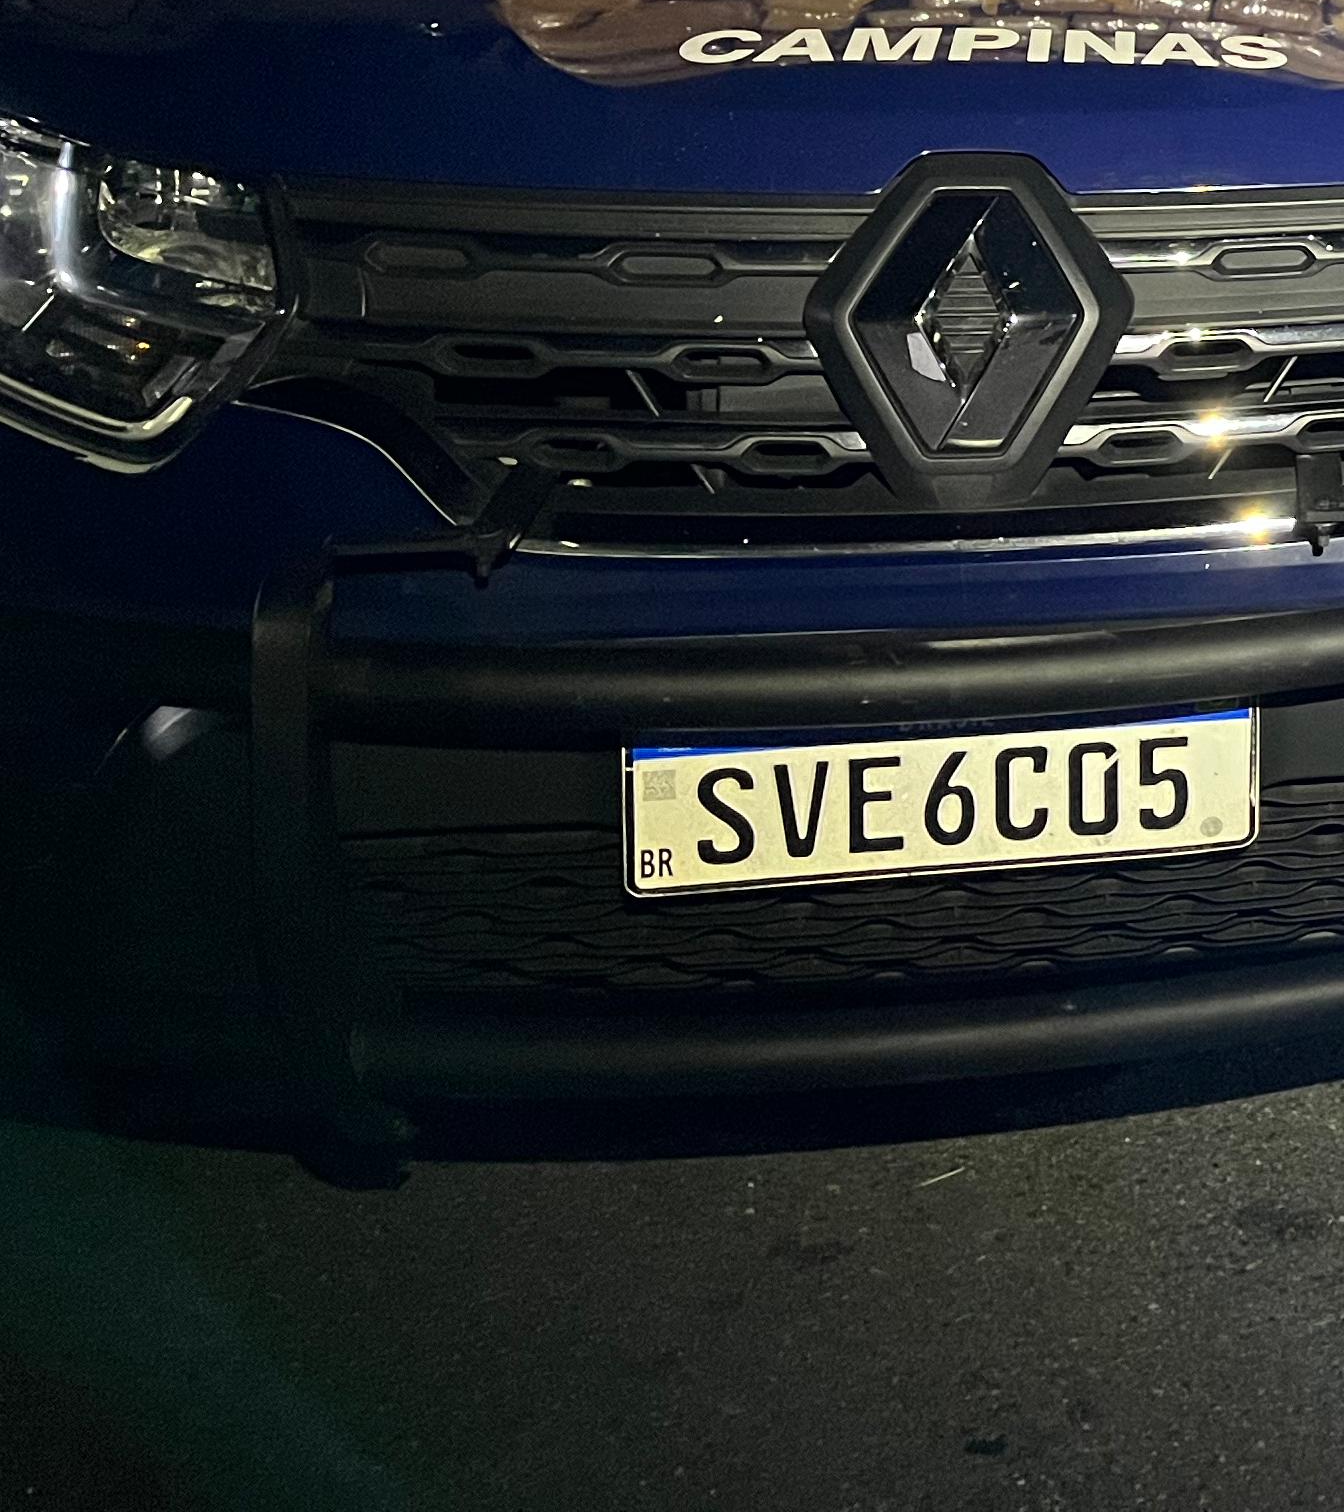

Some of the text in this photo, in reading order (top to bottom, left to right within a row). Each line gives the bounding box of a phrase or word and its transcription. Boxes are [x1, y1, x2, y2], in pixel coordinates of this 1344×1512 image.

[679, 28, 1288, 71] CAMPINAS
[697, 736, 1189, 865] SVE6C05
[640, 849, 674, 878] BR
